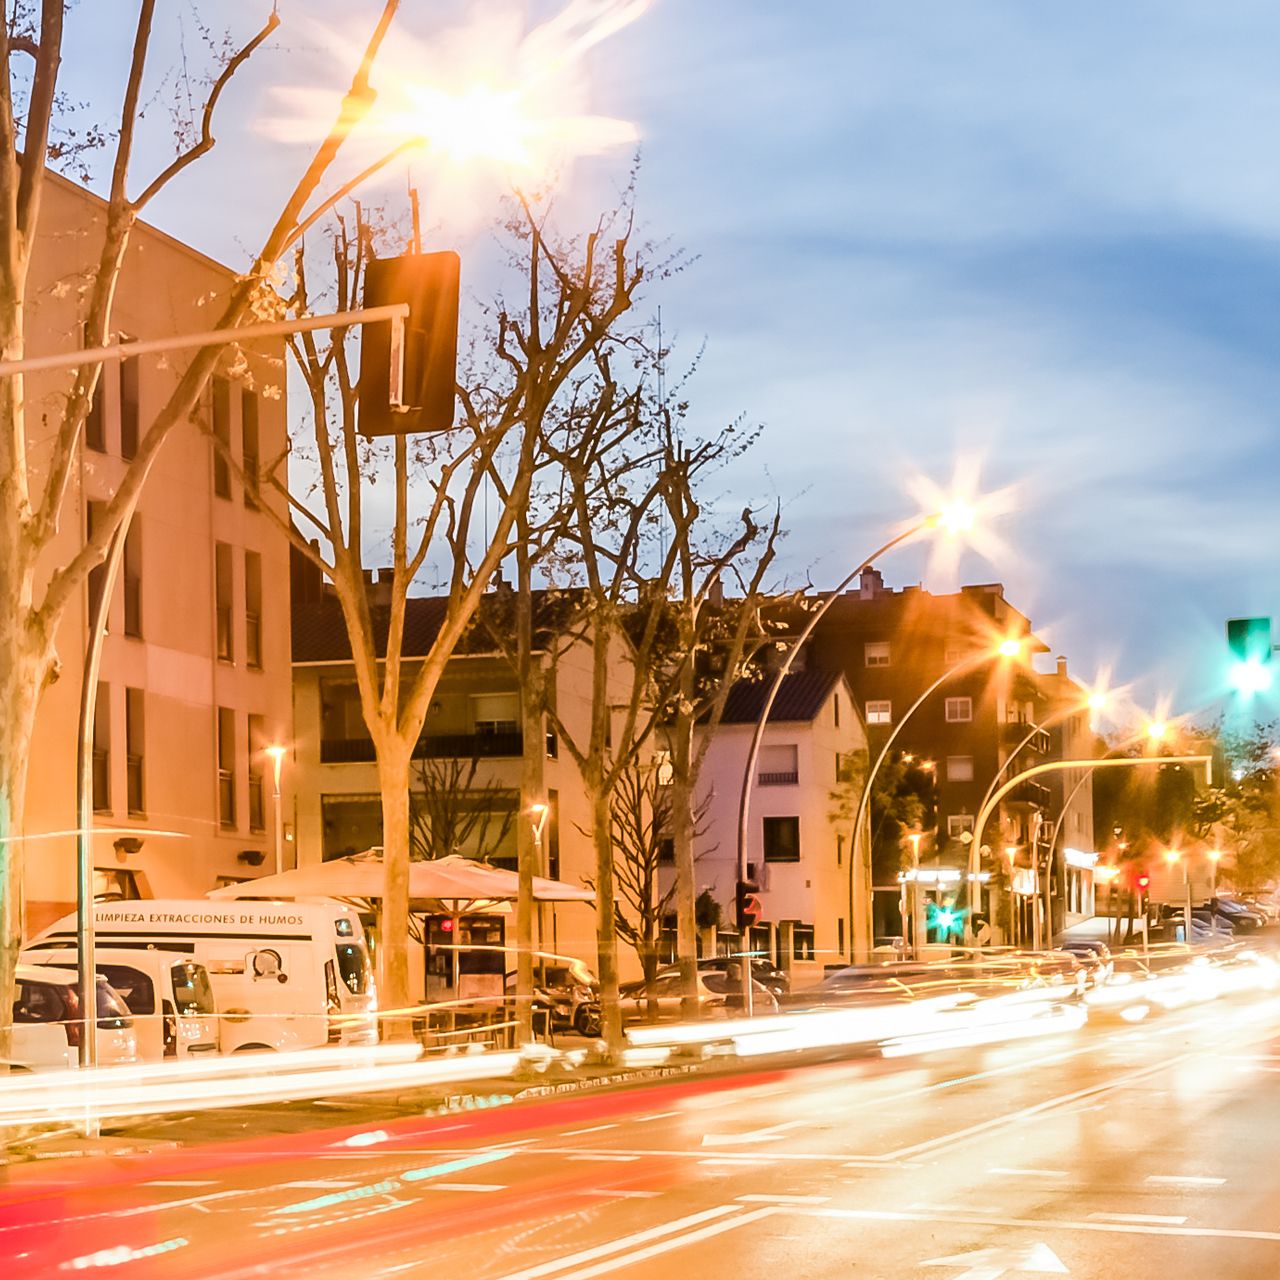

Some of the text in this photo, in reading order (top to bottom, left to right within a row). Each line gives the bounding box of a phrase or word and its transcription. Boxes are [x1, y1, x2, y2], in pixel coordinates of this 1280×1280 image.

[95, 913, 304, 925] LIMPIEZA EXTRACCIONES DE HUMOS
